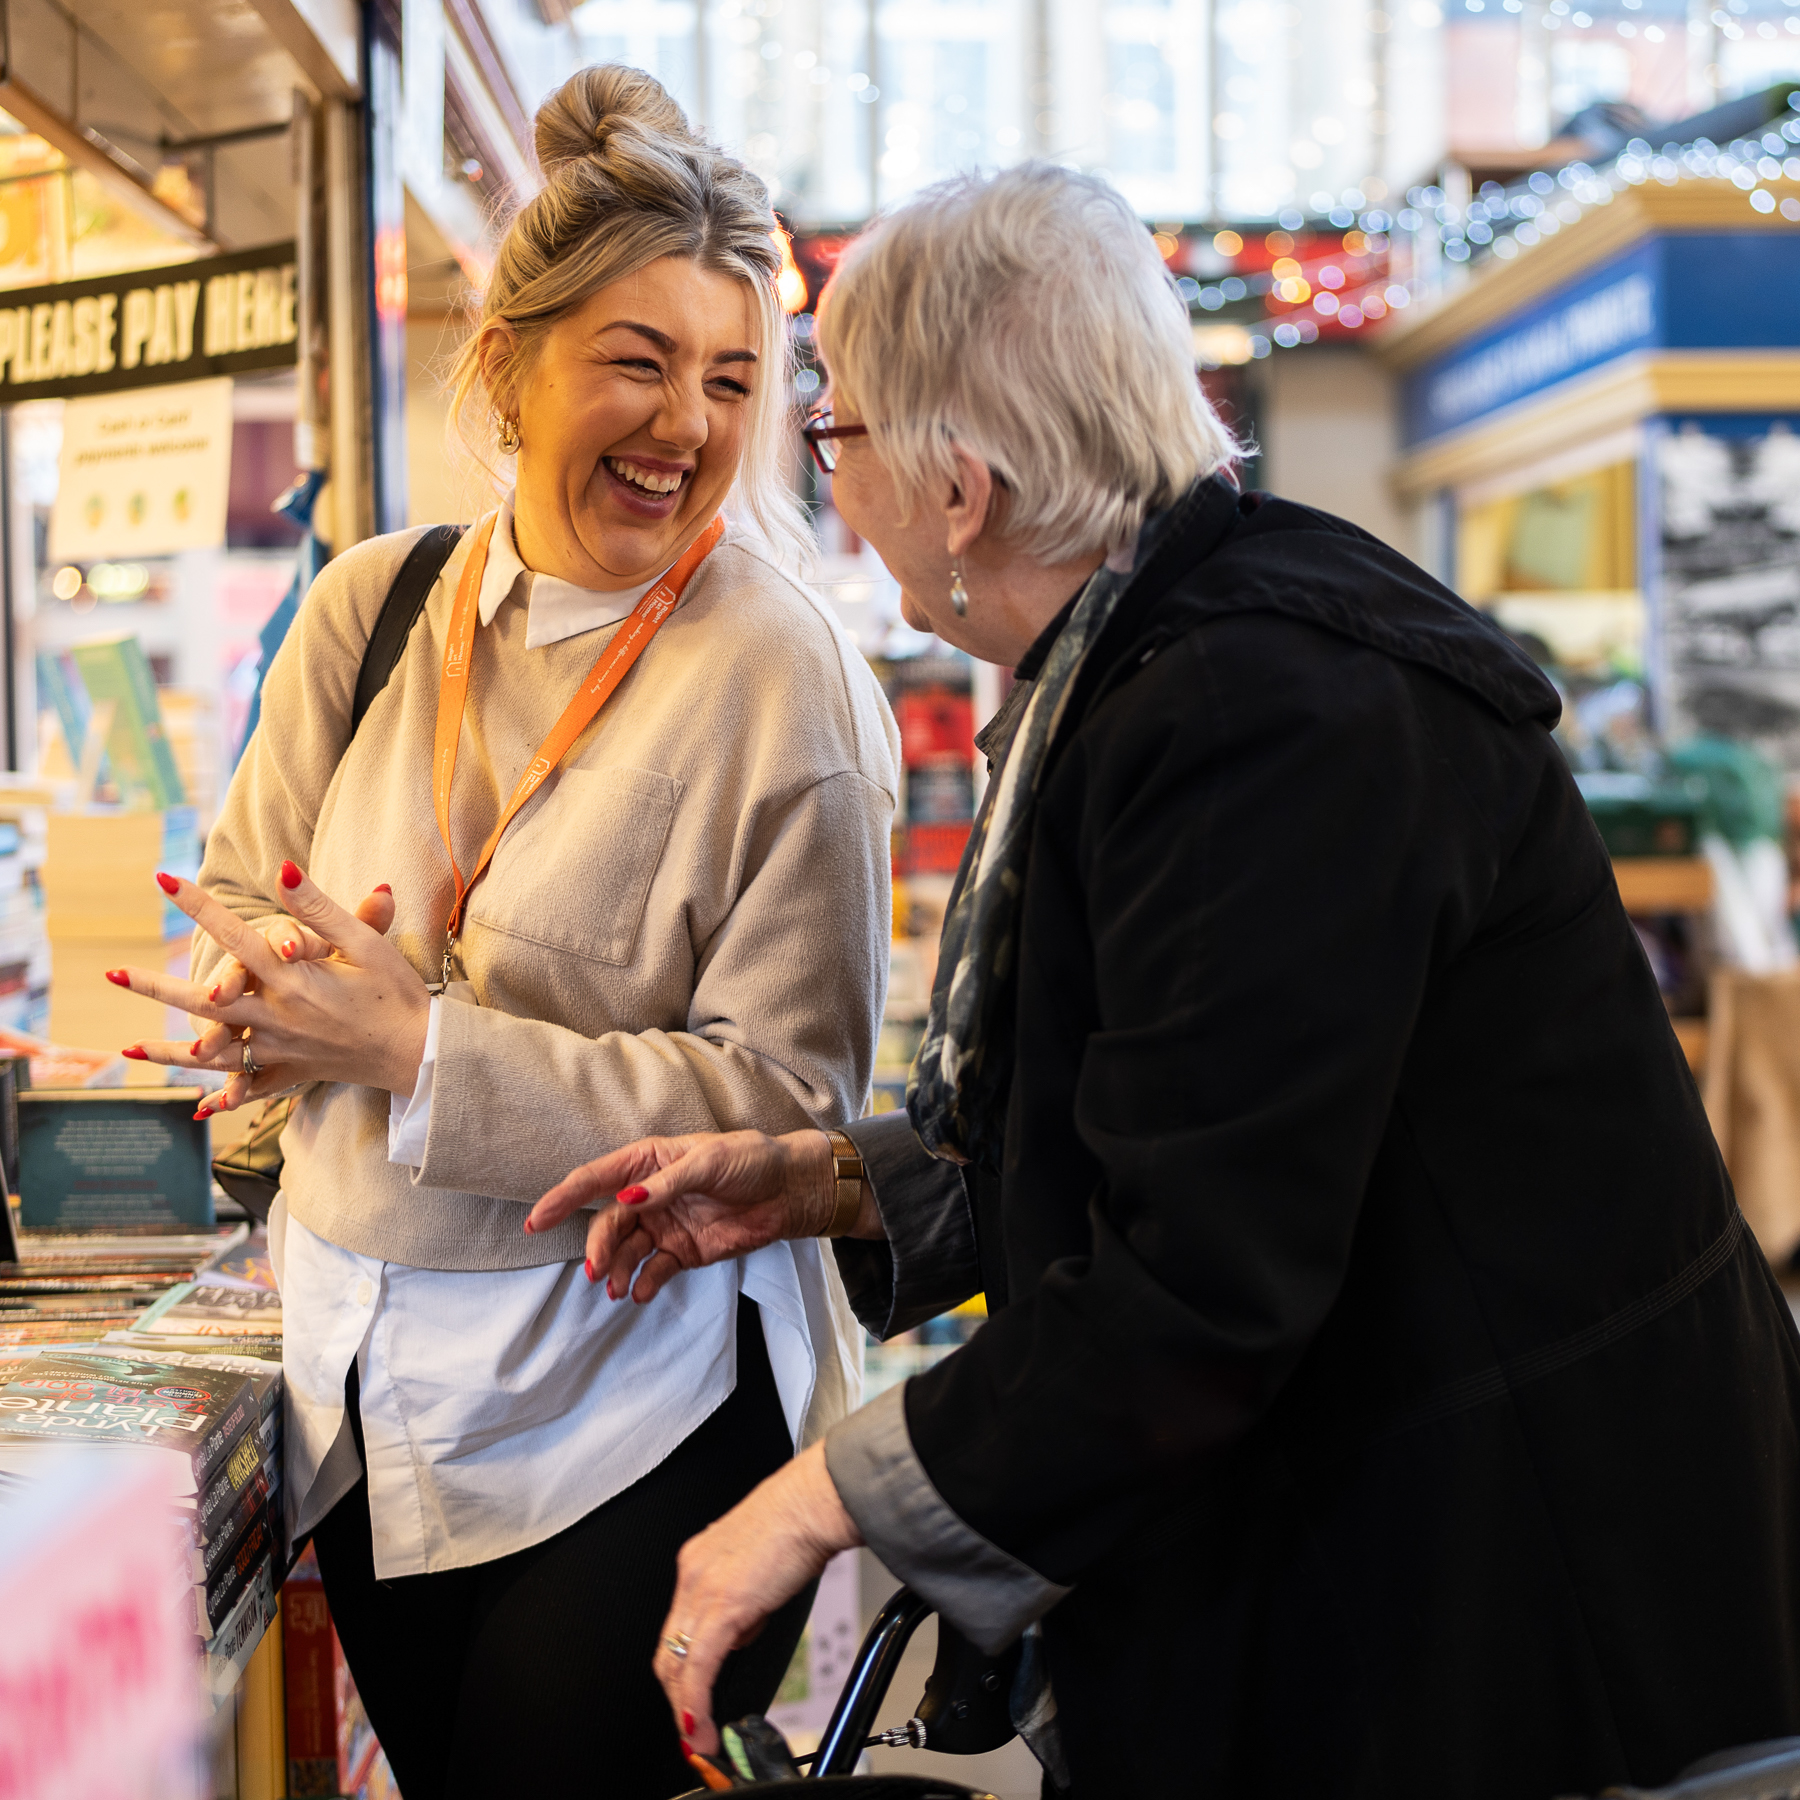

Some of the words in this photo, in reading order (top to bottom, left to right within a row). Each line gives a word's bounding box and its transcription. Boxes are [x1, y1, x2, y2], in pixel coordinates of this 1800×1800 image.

[0, 292, 118, 385] PLEASE
[120, 279, 201, 370] PAY
[203, 264, 298, 357] HERE
[641, 598, 658, 619] Home
[652, 605, 669, 624] Right
[447, 643, 455, 661] Right
[458, 641, 466, 660] Home
[19, 1379, 142, 1397] BLOOD
[43, 1390, 96, 1401] OF
[0, 1396, 208, 1432] Plante
[100, 1396, 209, 1415] TASTE
[15, 1413, 160, 1437] Lynda
[209, 1430, 224, 1454] Plante
[201, 1497, 213, 1526] Lynda
[215, 1475, 230, 1500] Plante
[226, 1433, 260, 1491] VANISHED
[223, 1565, 237, 1591] Plante
[236, 1594, 258, 1652] TENNISON
